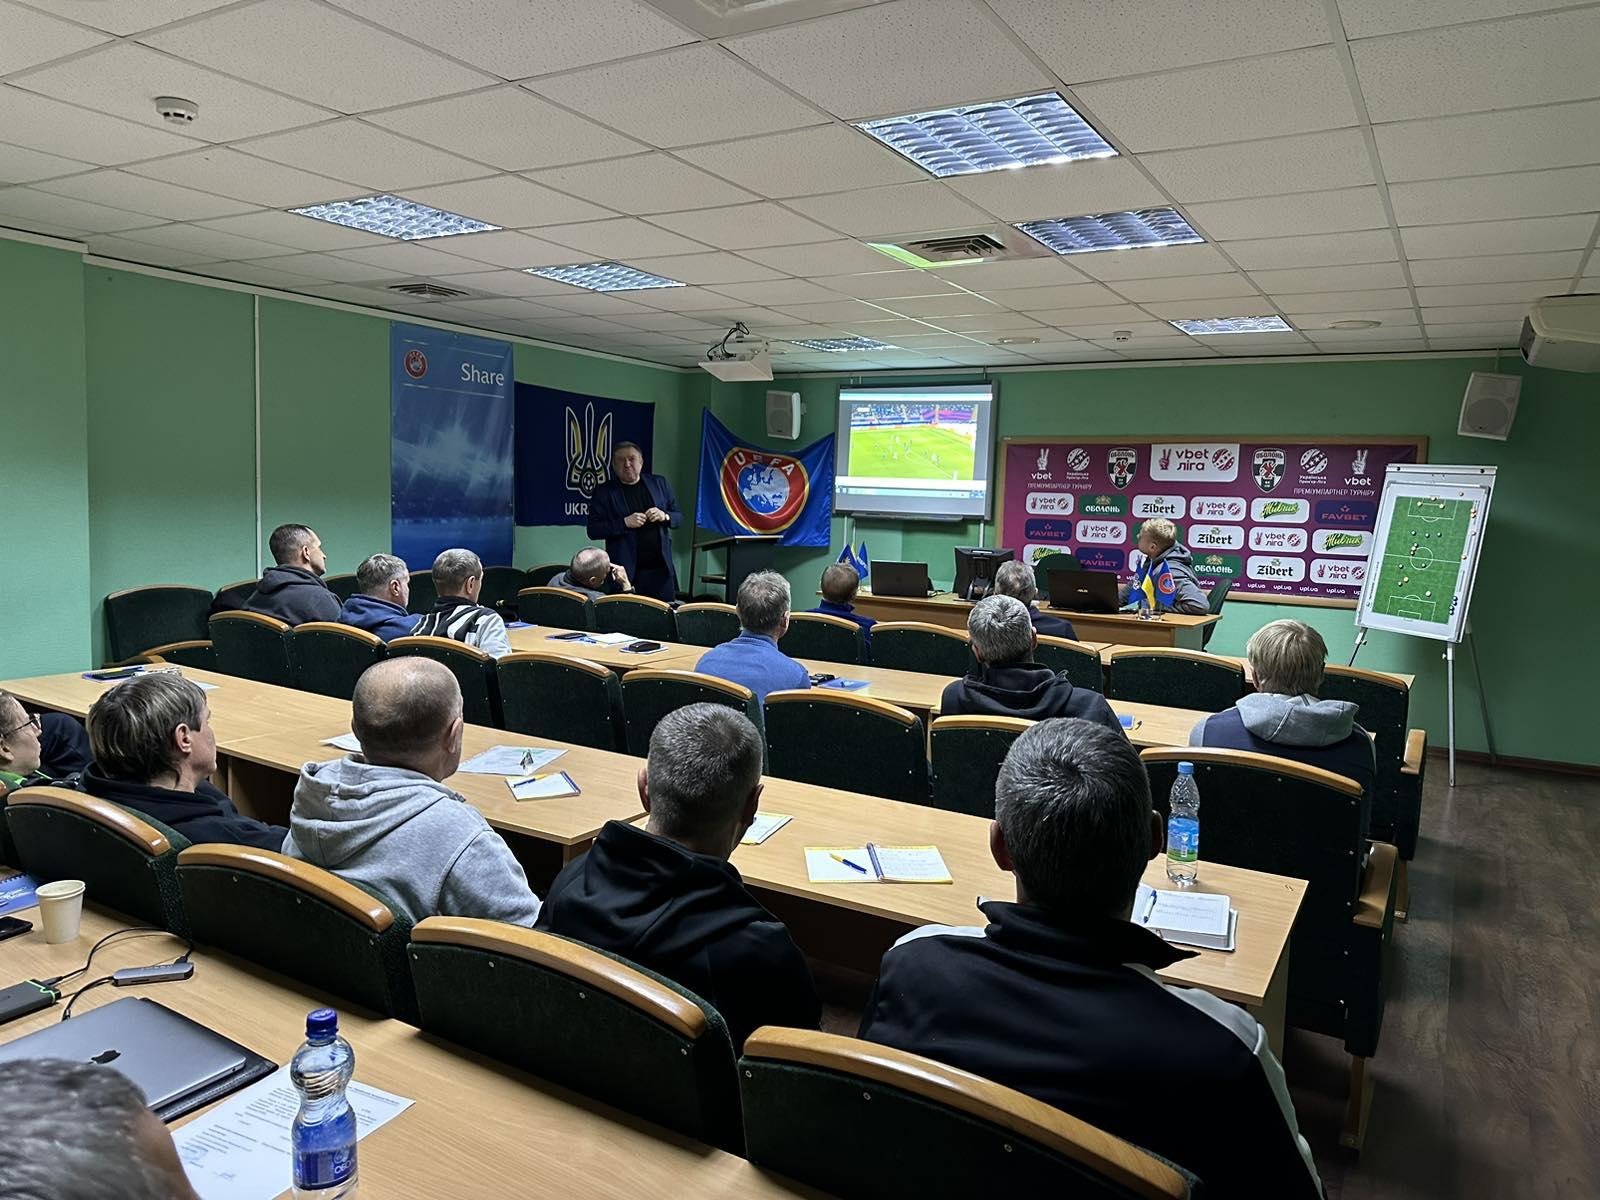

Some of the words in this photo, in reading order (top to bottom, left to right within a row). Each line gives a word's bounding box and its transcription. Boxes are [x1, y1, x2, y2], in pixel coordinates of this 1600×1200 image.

[461, 363, 505, 386] Share
[1175, 449, 1208, 460] vbet
[733, 451, 796, 476] UEFA
[1177, 460, 1205, 471] ліга
[1031, 472, 1053, 480] vbet
[1344, 477, 1372, 486] vbet
[1321, 513, 1368, 521] FAVBET
[1265, 532, 1286, 540] vbet
[1328, 565, 1349, 573] vbet
